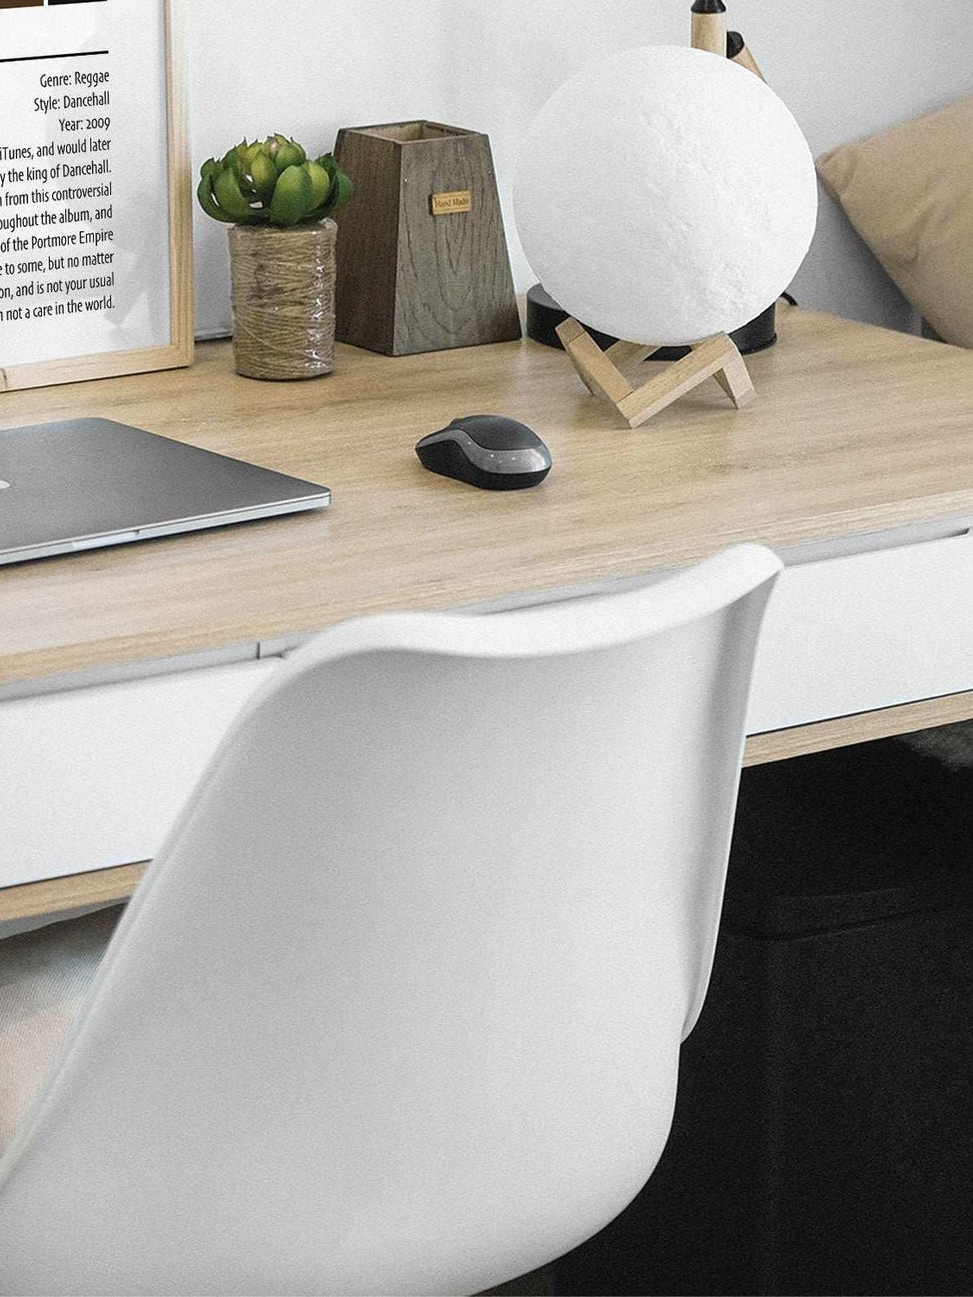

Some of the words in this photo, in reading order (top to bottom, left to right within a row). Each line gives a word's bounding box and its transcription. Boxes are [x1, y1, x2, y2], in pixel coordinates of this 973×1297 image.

[39, 73, 71, 87] Genre:
[74, 71, 109, 87] Reggae
[33, 95, 60, 114] Style:
[63, 90, 109, 108] Dancehall
[58, 118, 83, 131] Year:
[85, 116, 110, 130] 2009
[0, 146, 34, 160] iTunes,
[36, 141, 54, 157] and
[56, 138, 86, 154] would
[89, 137, 111, 152] later
[7, 168, 24, 182] the
[26, 166, 47, 183] king
[49, 163, 60, 178] of
[62, 158, 111, 177] Dancehall.
[4, 191, 28, 206] from
[31, 188, 49, 203] this
[51, 181, 111, 201] controversial
[40, 210, 56, 225] the
[58, 208, 92, 223] album,
[94, 204, 112, 220] and
[15, 280, 34, 297] and
[36, 280, 44, 294] is
[46, 279, 63, 293] not
[64, 278, 87, 295] your
[89, 271, 114, 288] usual
[6, 307, 22, 320] not
[24, 307, 30, 319] a
[32, 305, 52, 317] care
[54, 301, 64, 314] in
[66, 299, 82, 313] the
[84, 294, 115, 311] world.
